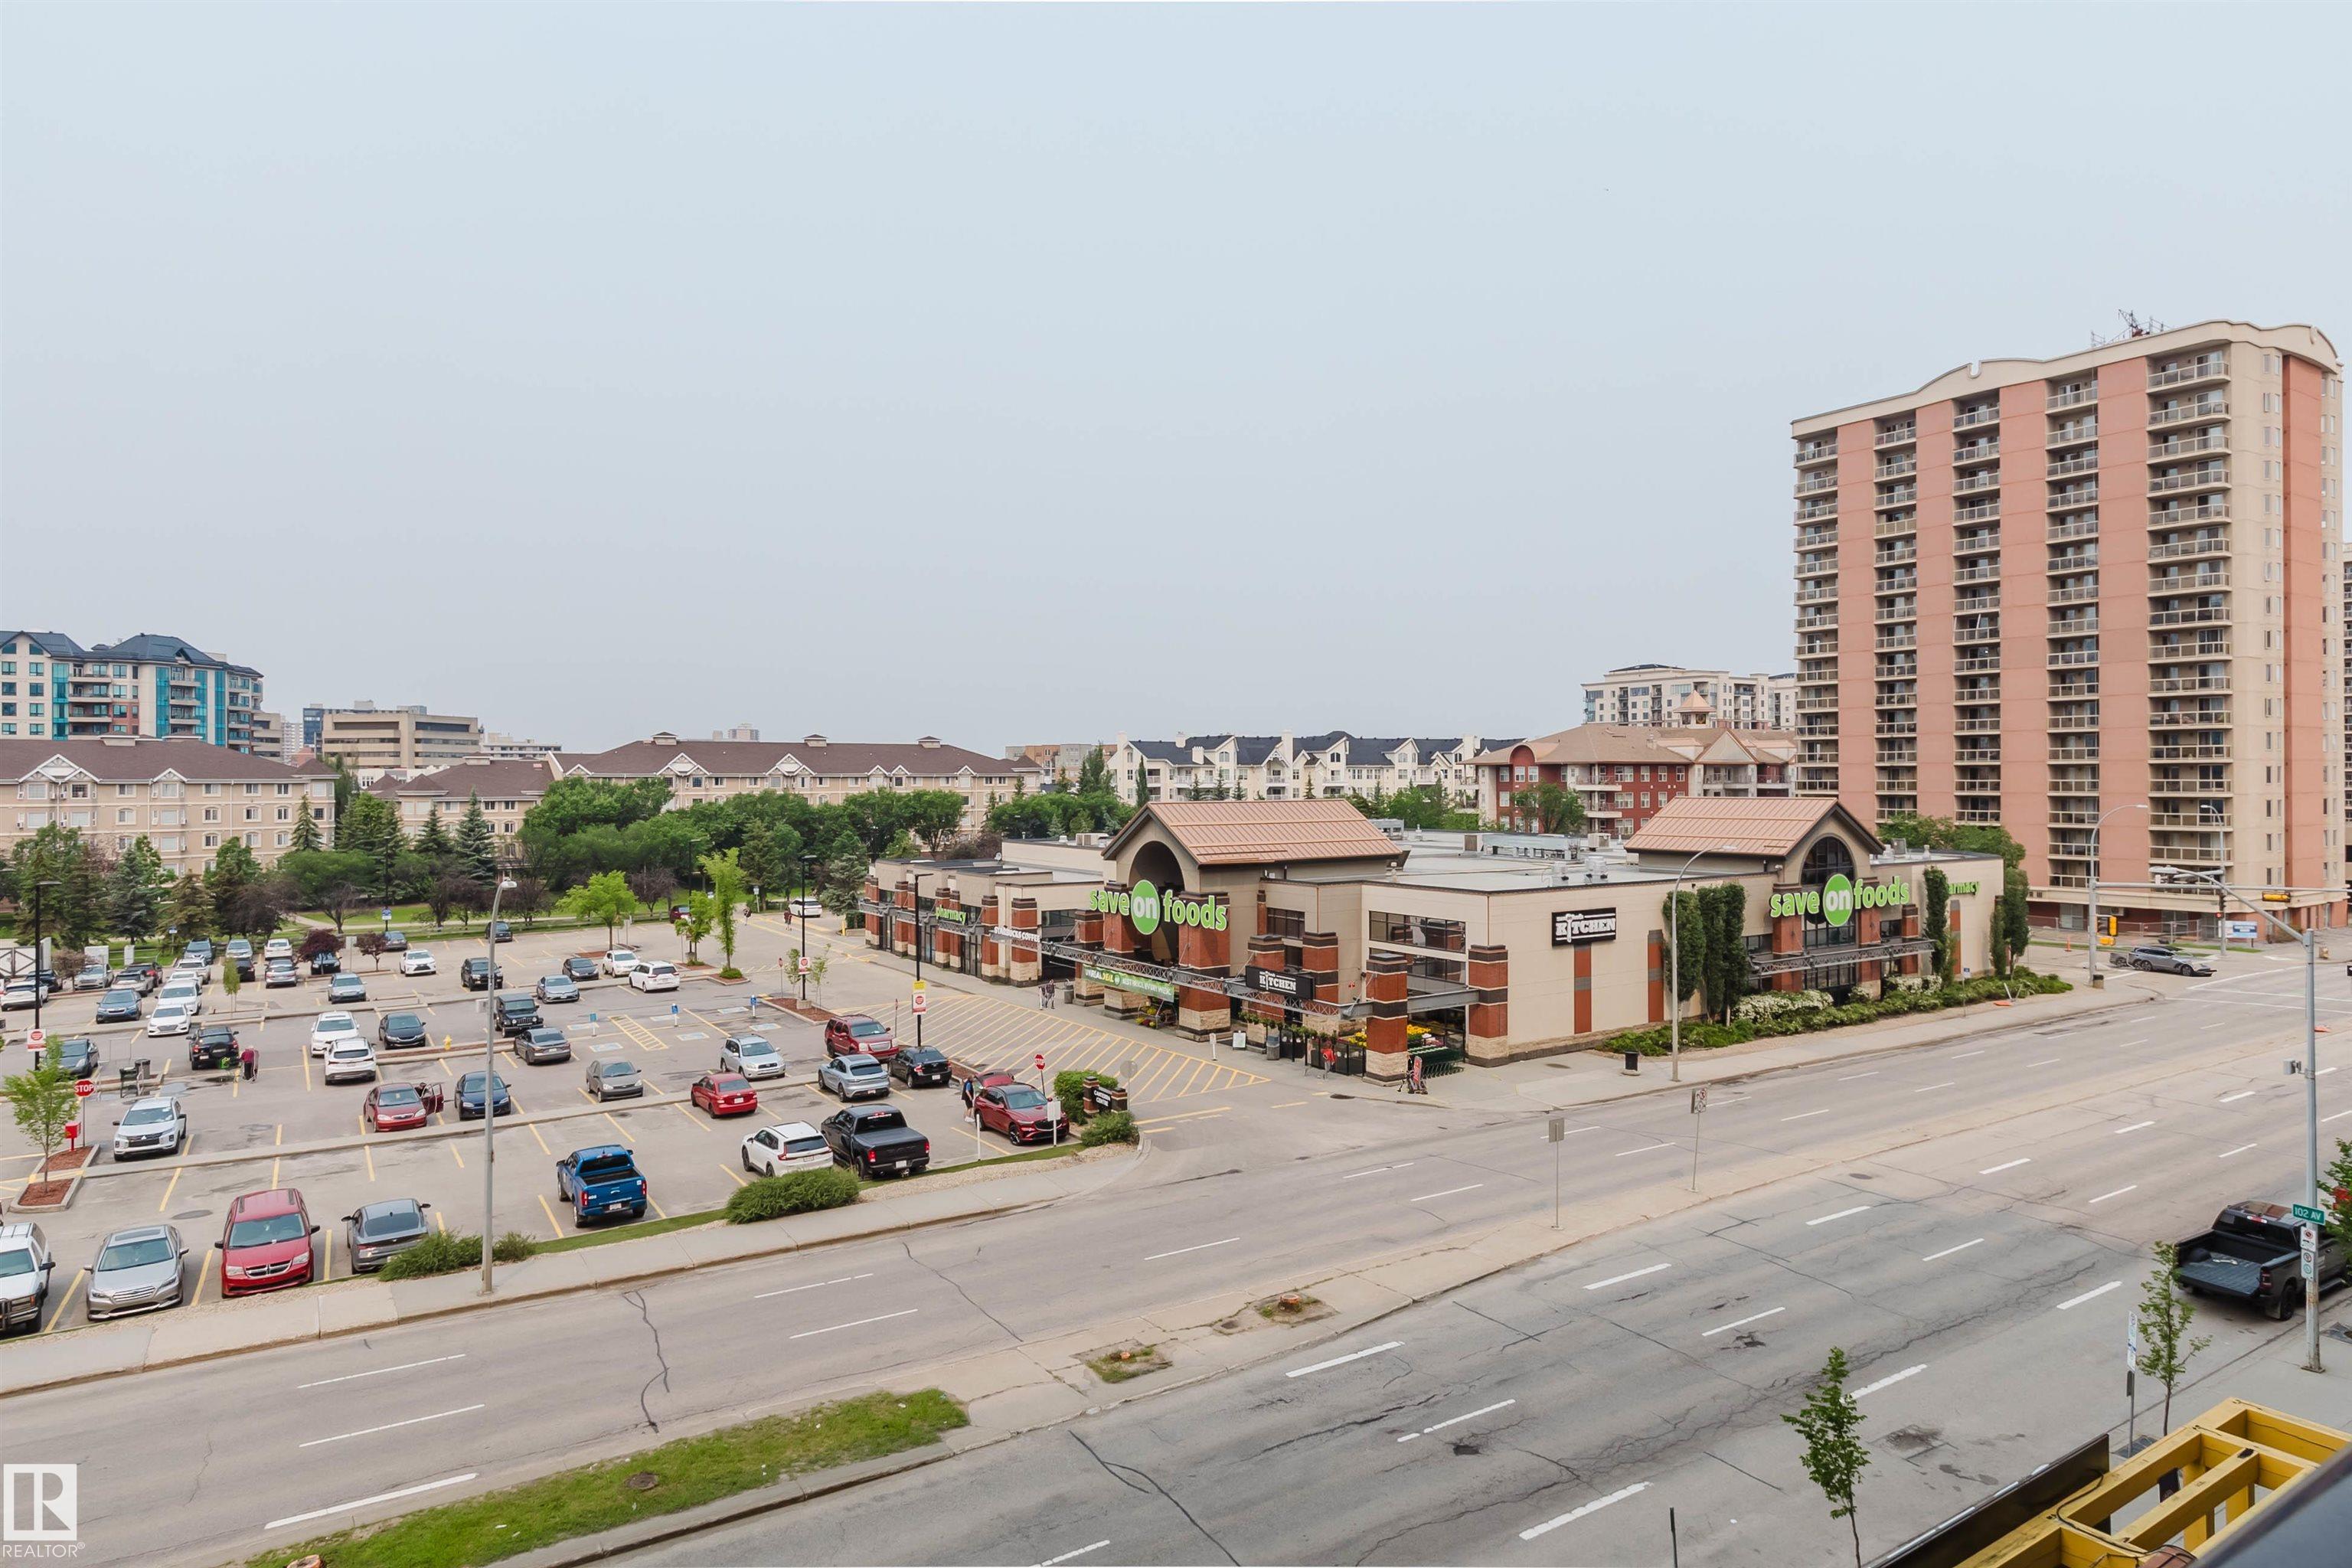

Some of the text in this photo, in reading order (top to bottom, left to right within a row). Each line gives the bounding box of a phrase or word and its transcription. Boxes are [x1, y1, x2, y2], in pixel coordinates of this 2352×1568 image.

[1948, 882, 1980, 894] armacy
[1770, 876, 1909, 918] save on foods
[935, 904, 966, 925] pharmacy
[1089, 889, 1227, 931] save on foods
[1556, 918, 1615, 936] KITCHEN
[1021, 932, 1041, 942] COFFEE
[1259, 974, 1296, 991] KITCHEN
[2295, 1207, 2322, 1220] 102 AV
